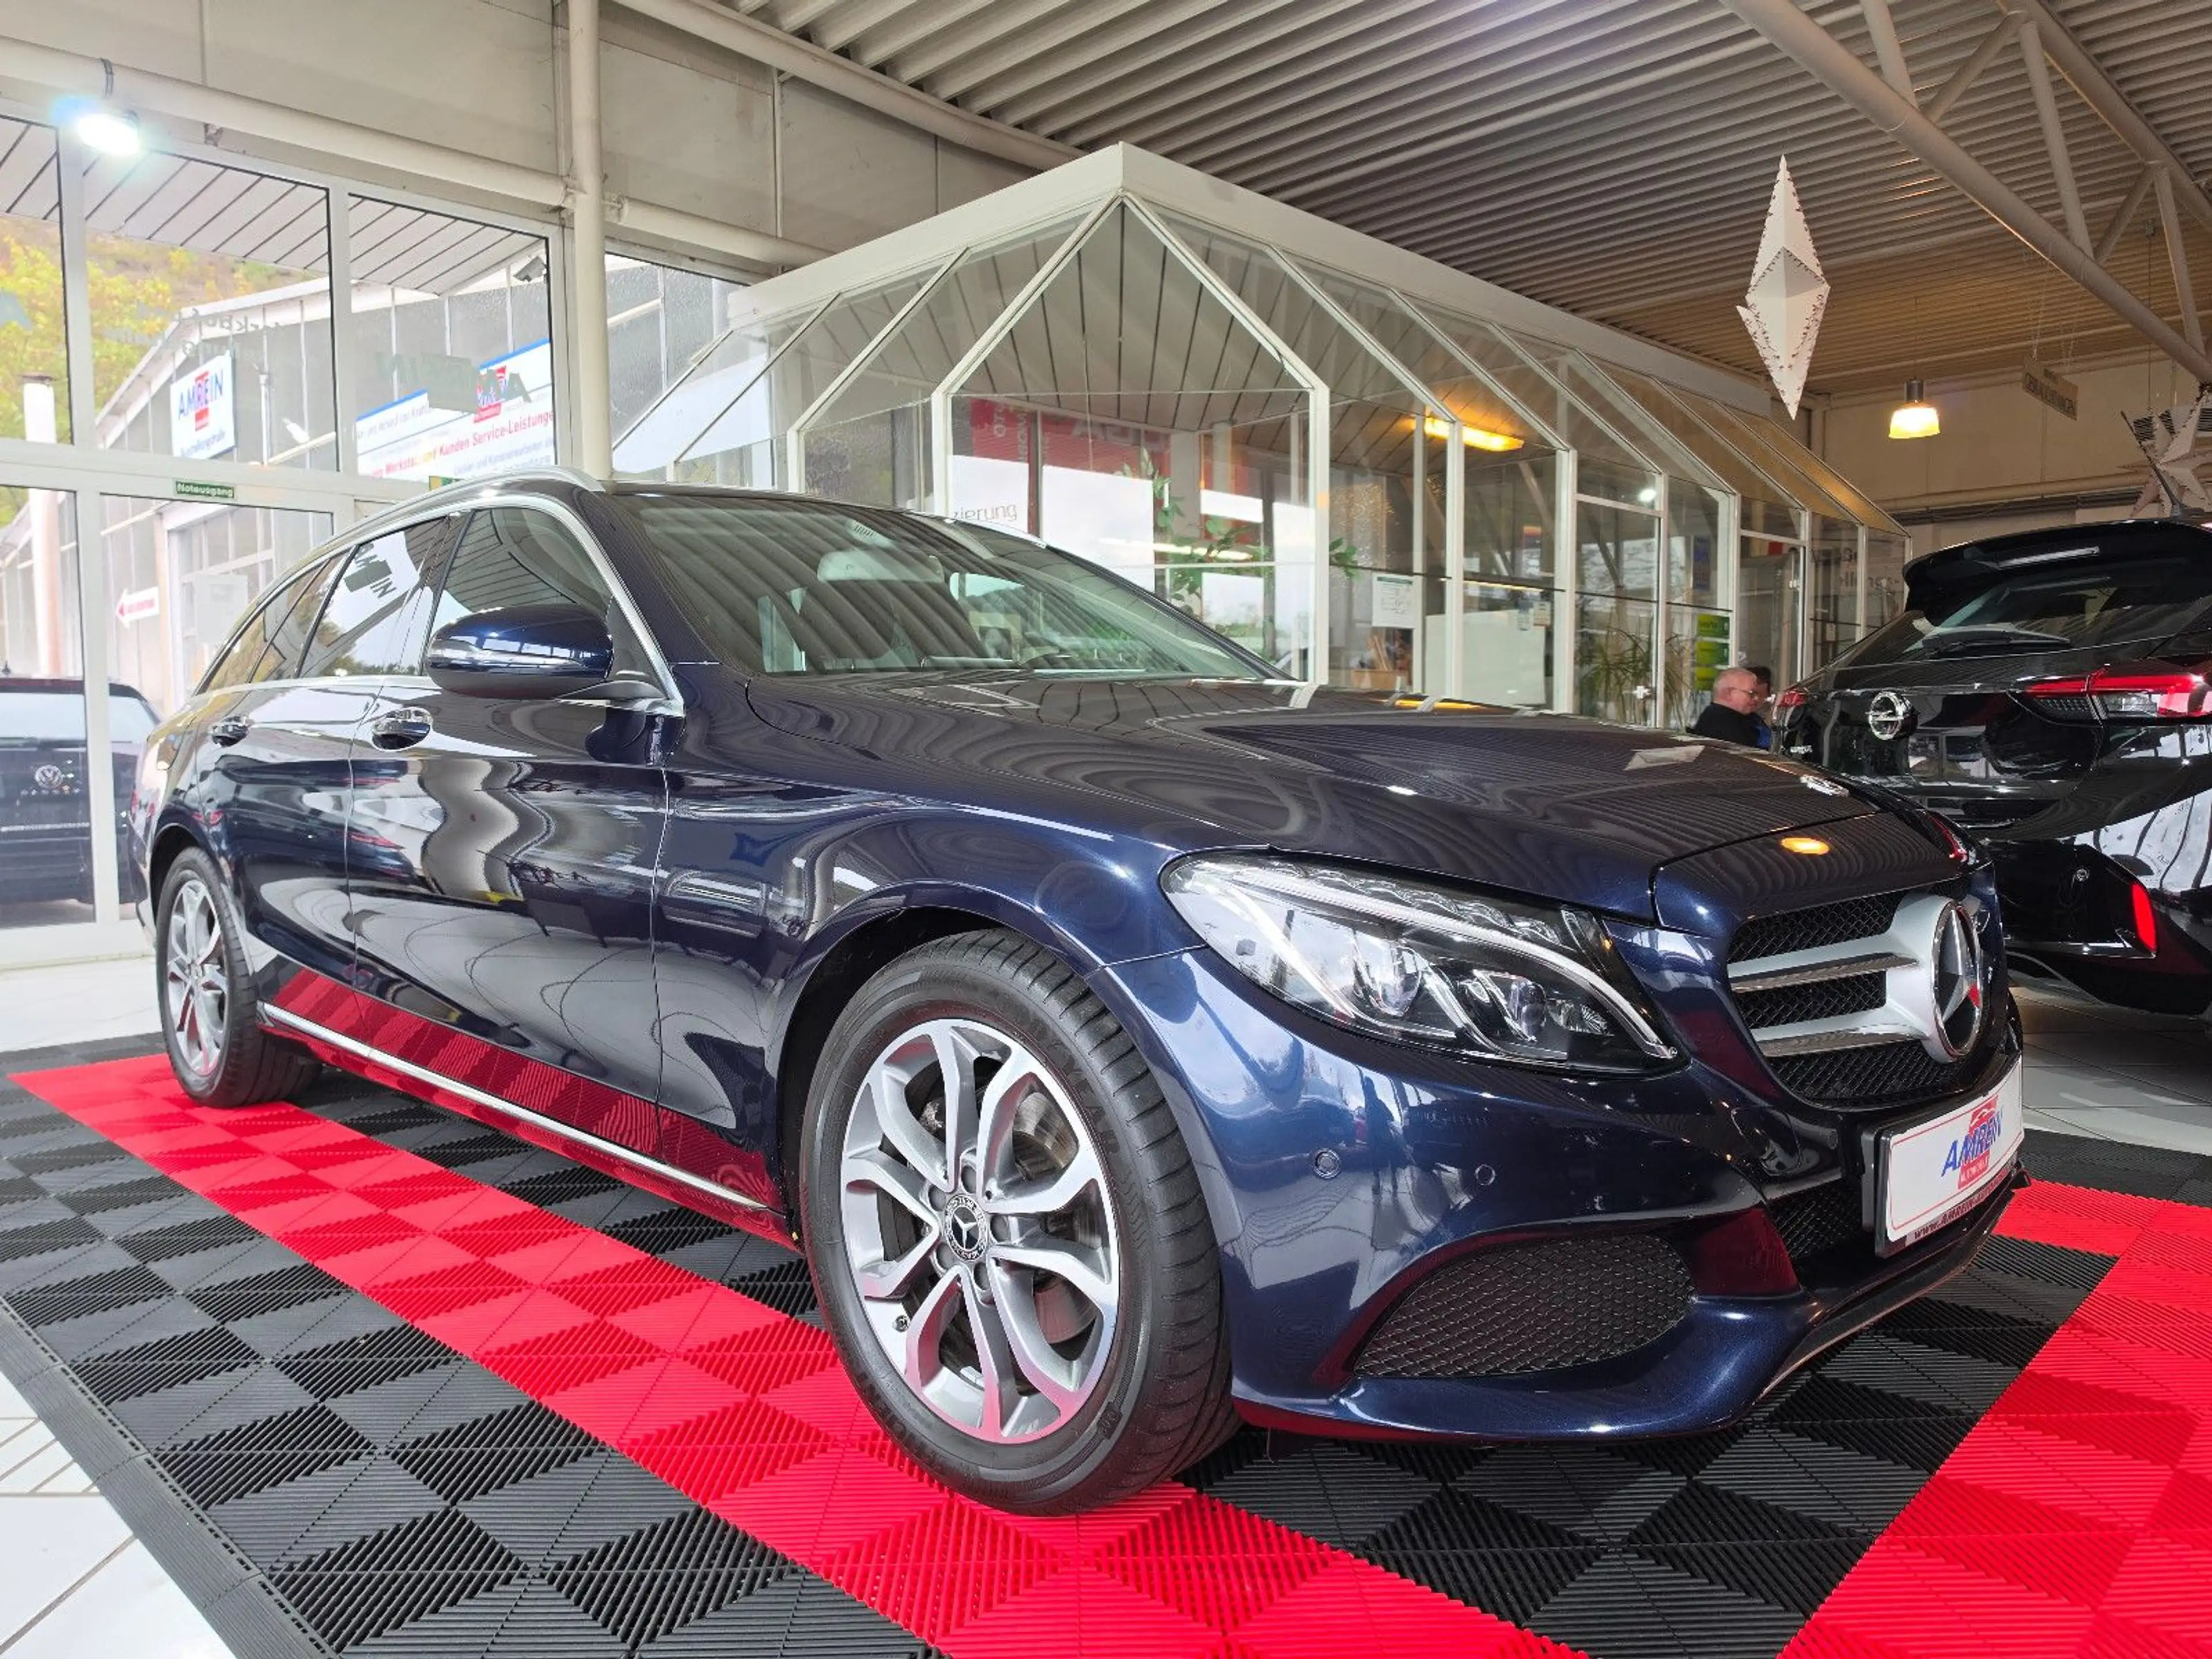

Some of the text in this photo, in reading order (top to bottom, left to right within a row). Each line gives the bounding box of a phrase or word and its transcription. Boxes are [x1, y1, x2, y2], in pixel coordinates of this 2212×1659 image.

[178, 368, 224, 421] AMREIN
[439, 436, 469, 458] Kunden
[1940, 1105, 2003, 1178] AMREIN
